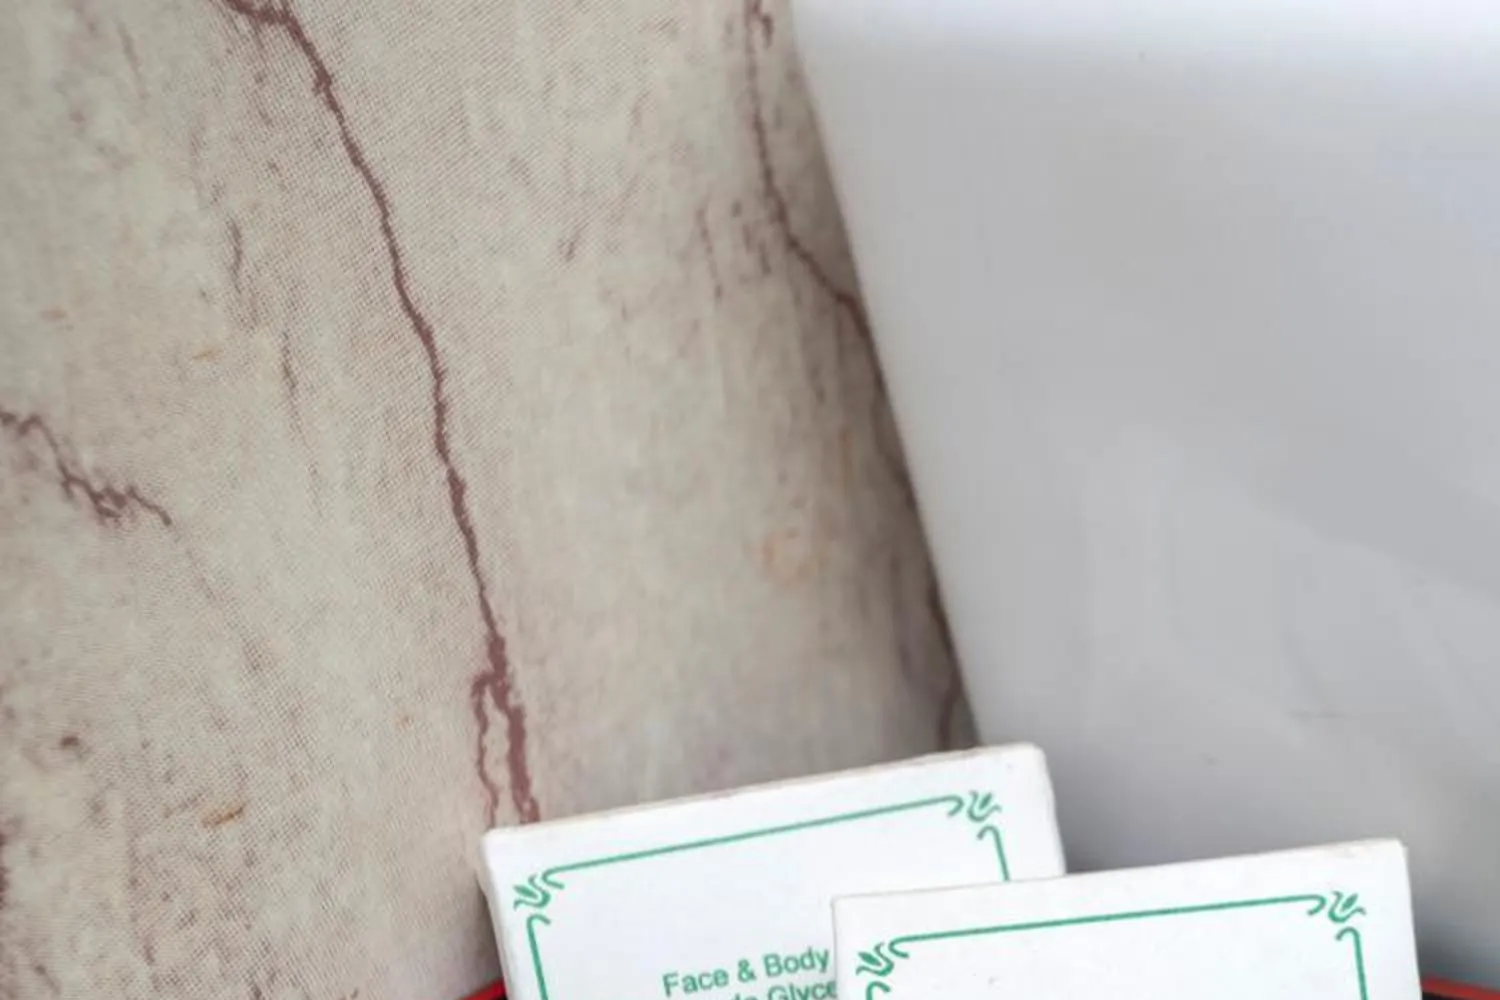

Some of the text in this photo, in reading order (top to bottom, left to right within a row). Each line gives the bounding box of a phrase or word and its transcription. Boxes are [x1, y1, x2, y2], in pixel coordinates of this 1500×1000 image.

[662, 947, 831, 997] Face & Body
